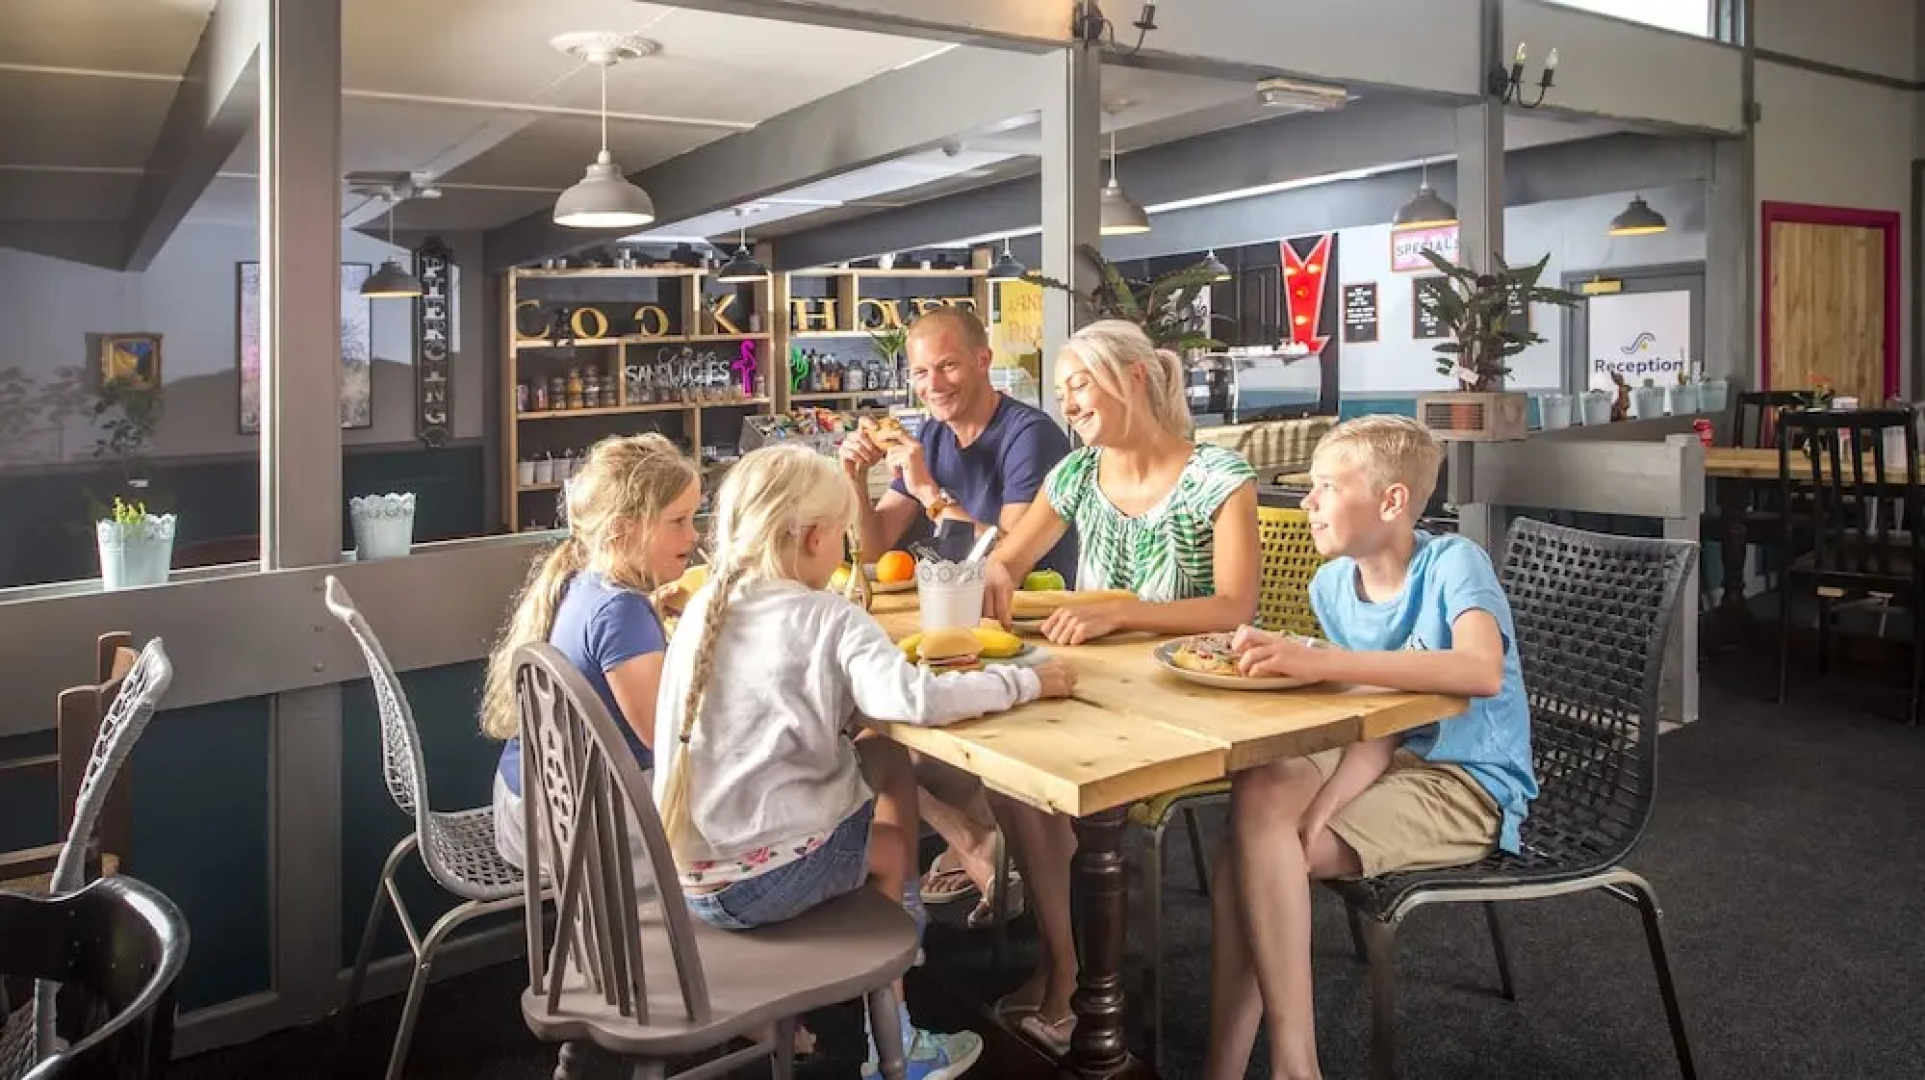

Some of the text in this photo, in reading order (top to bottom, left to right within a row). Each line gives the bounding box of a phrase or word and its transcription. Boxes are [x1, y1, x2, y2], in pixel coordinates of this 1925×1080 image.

[1397, 238, 1459, 256] SPECIAL
[423, 257, 447, 424] PIERCING
[1594, 356, 1683, 375] Reception
